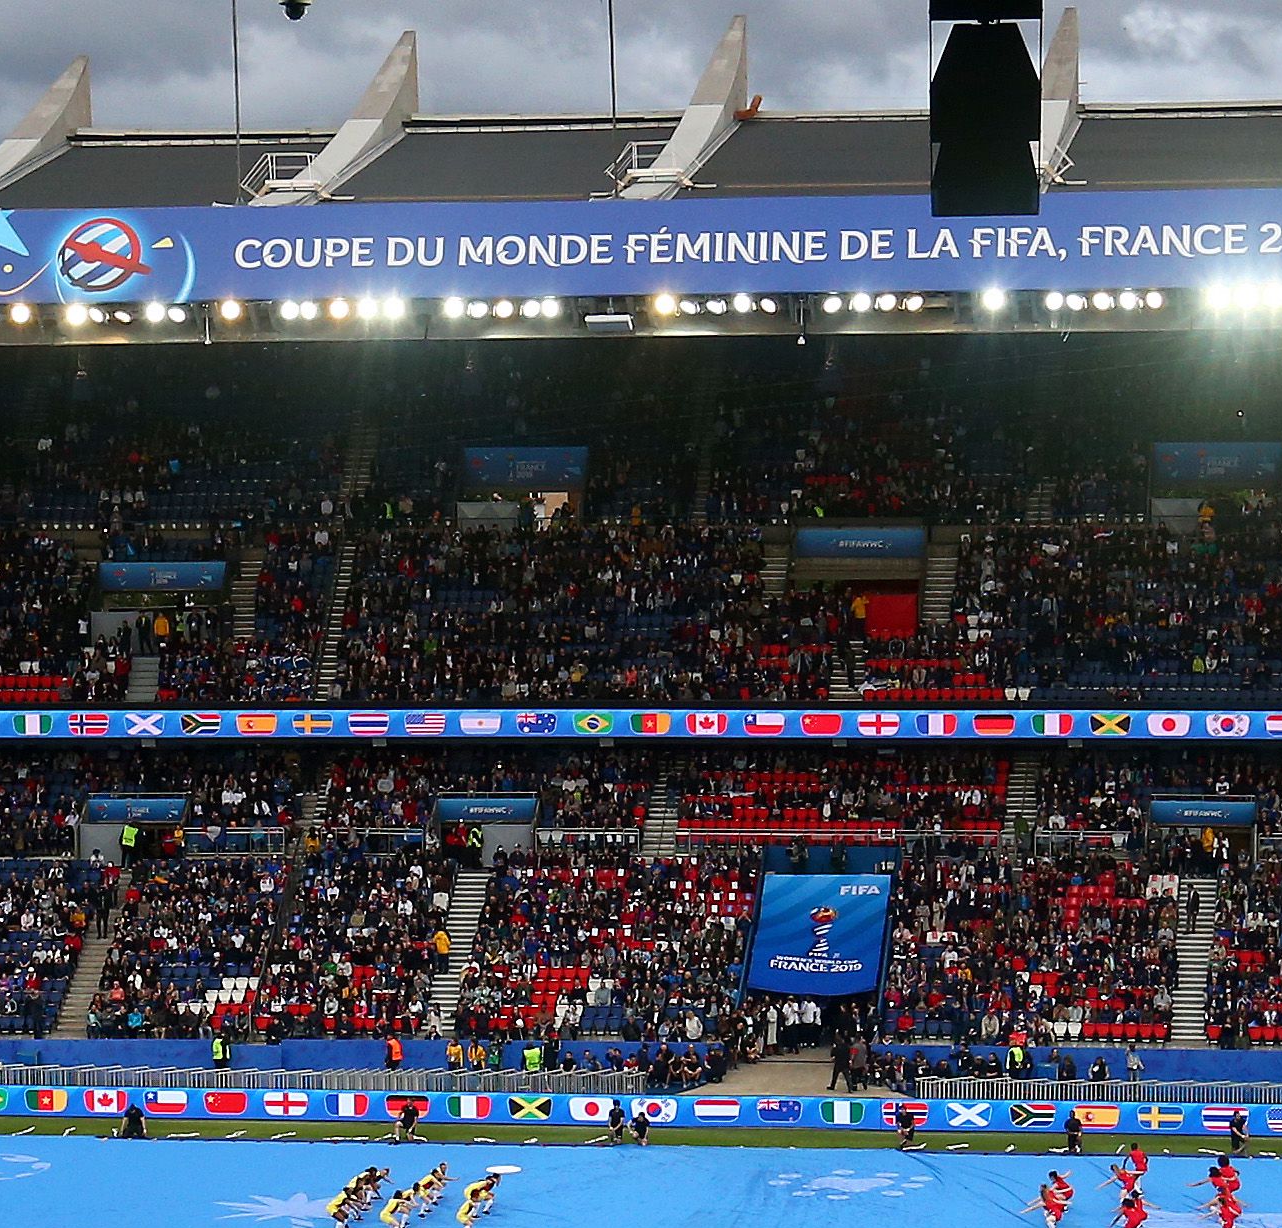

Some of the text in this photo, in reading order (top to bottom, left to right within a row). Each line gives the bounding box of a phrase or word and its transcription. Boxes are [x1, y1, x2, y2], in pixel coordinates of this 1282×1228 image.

[234, 236, 375, 269] COUPE
[386, 235, 445, 268] DU
[458, 233, 614, 268] MONDE
[622, 225, 828, 265] FÉMININE
[840, 228, 895, 261] DE
[907, 227, 960, 260] LA
[968, 225, 1067, 263] FIFA,
[1077, 222, 1248, 258] FRANCE
[839, 885, 881, 896] FIFA
[769, 959, 863, 973] FRANCE 2019
